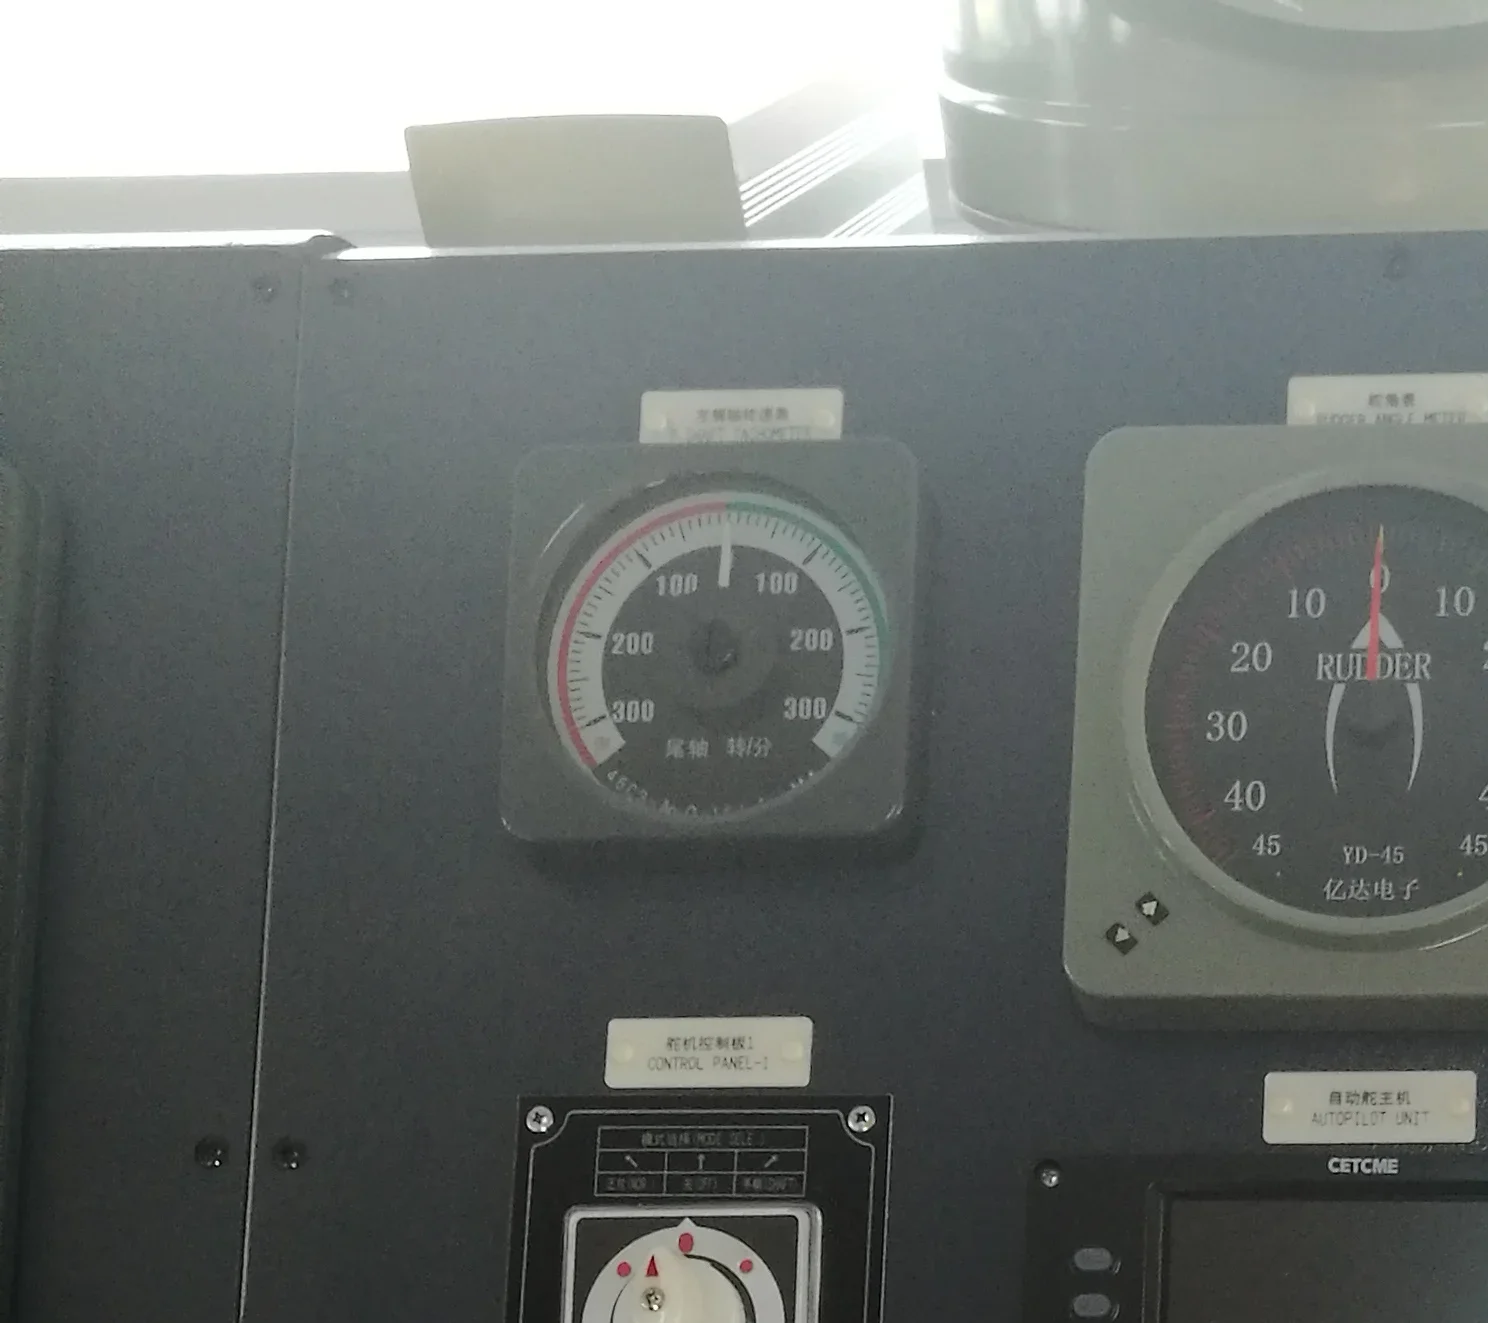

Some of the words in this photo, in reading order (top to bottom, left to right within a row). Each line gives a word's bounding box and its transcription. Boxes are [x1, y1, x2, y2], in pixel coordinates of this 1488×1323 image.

[656, 573, 699, 597] 100
[755, 571, 798, 595] 100
[1287, 587, 1326, 619] 10
[1436, 586, 1476, 618] 10
[611, 631, 655, 656] 200
[790, 628, 834, 653] 200
[1230, 642, 1272, 673] 20
[1317, 652, 1432, 682] RUDDER
[612, 699, 655, 723] 300
[783, 697, 828, 721] 300
[1206, 711, 1249, 742] 30
[1223, 780, 1267, 813] 40
[1252, 834, 1282, 857] 45
[1459, 834, 1488, 857] 45
[1342, 844, 1405, 866] YD-45
[1322, 877, 1421, 902] 亿达电子
[647, 1056, 704, 1071] CONTROL
[1329, 1090, 1412, 1106] 自动舵主机
[1311, 1111, 1387, 1127] AUTOPILOT
[1395, 1111, 1430, 1126] UNIT
[1327, 1157, 1399, 1174] CETCME
